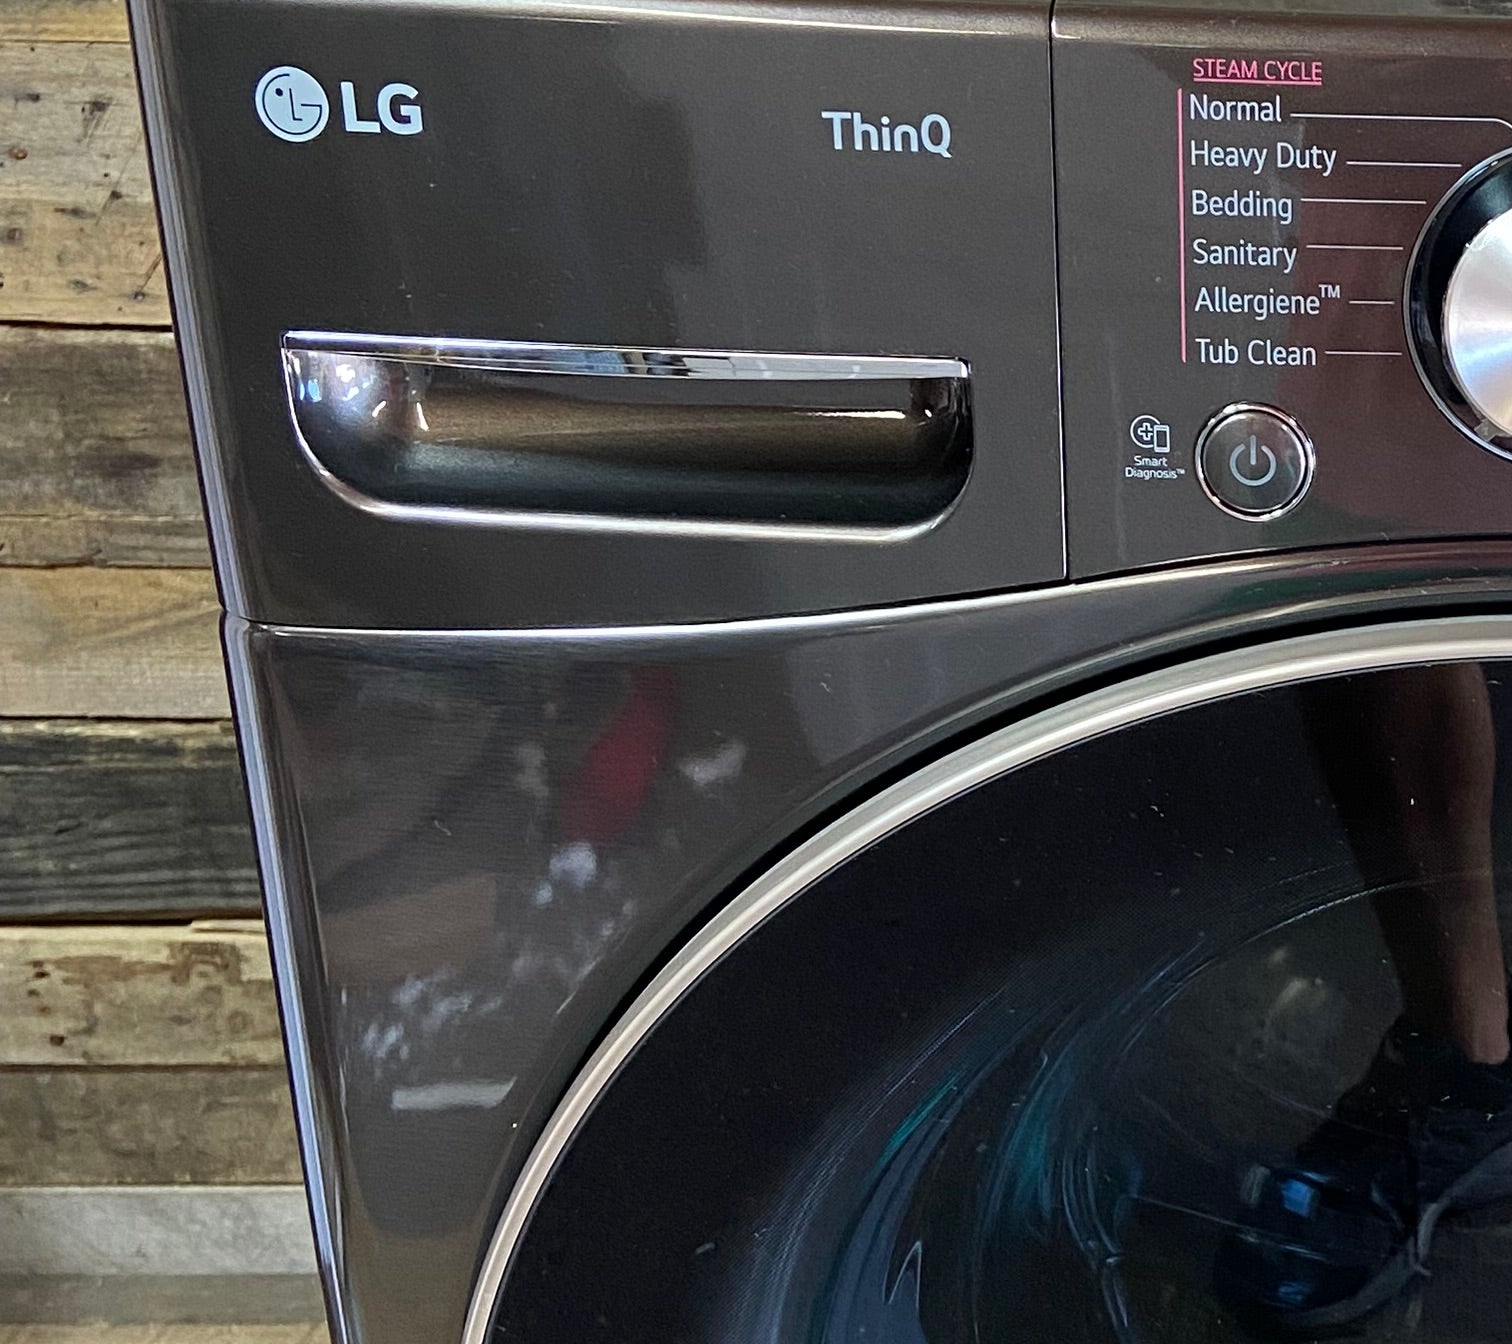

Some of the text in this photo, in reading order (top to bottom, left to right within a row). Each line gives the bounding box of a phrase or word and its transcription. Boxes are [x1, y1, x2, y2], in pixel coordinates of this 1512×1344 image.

[1192, 58, 1323, 82] STEAM CYCLE
[340, 81, 423, 136] LG
[1189, 94, 1282, 122] Normal
[821, 111, 952, 158] ThinQ
[1190, 139, 1337, 177] Heavy Duty
[1191, 189, 1293, 225] Bedding
[1192, 238, 1298, 274] Sanitary
[1195, 338, 1317, 366] Tub Clean
[1133, 455, 1168, 467] Smart
